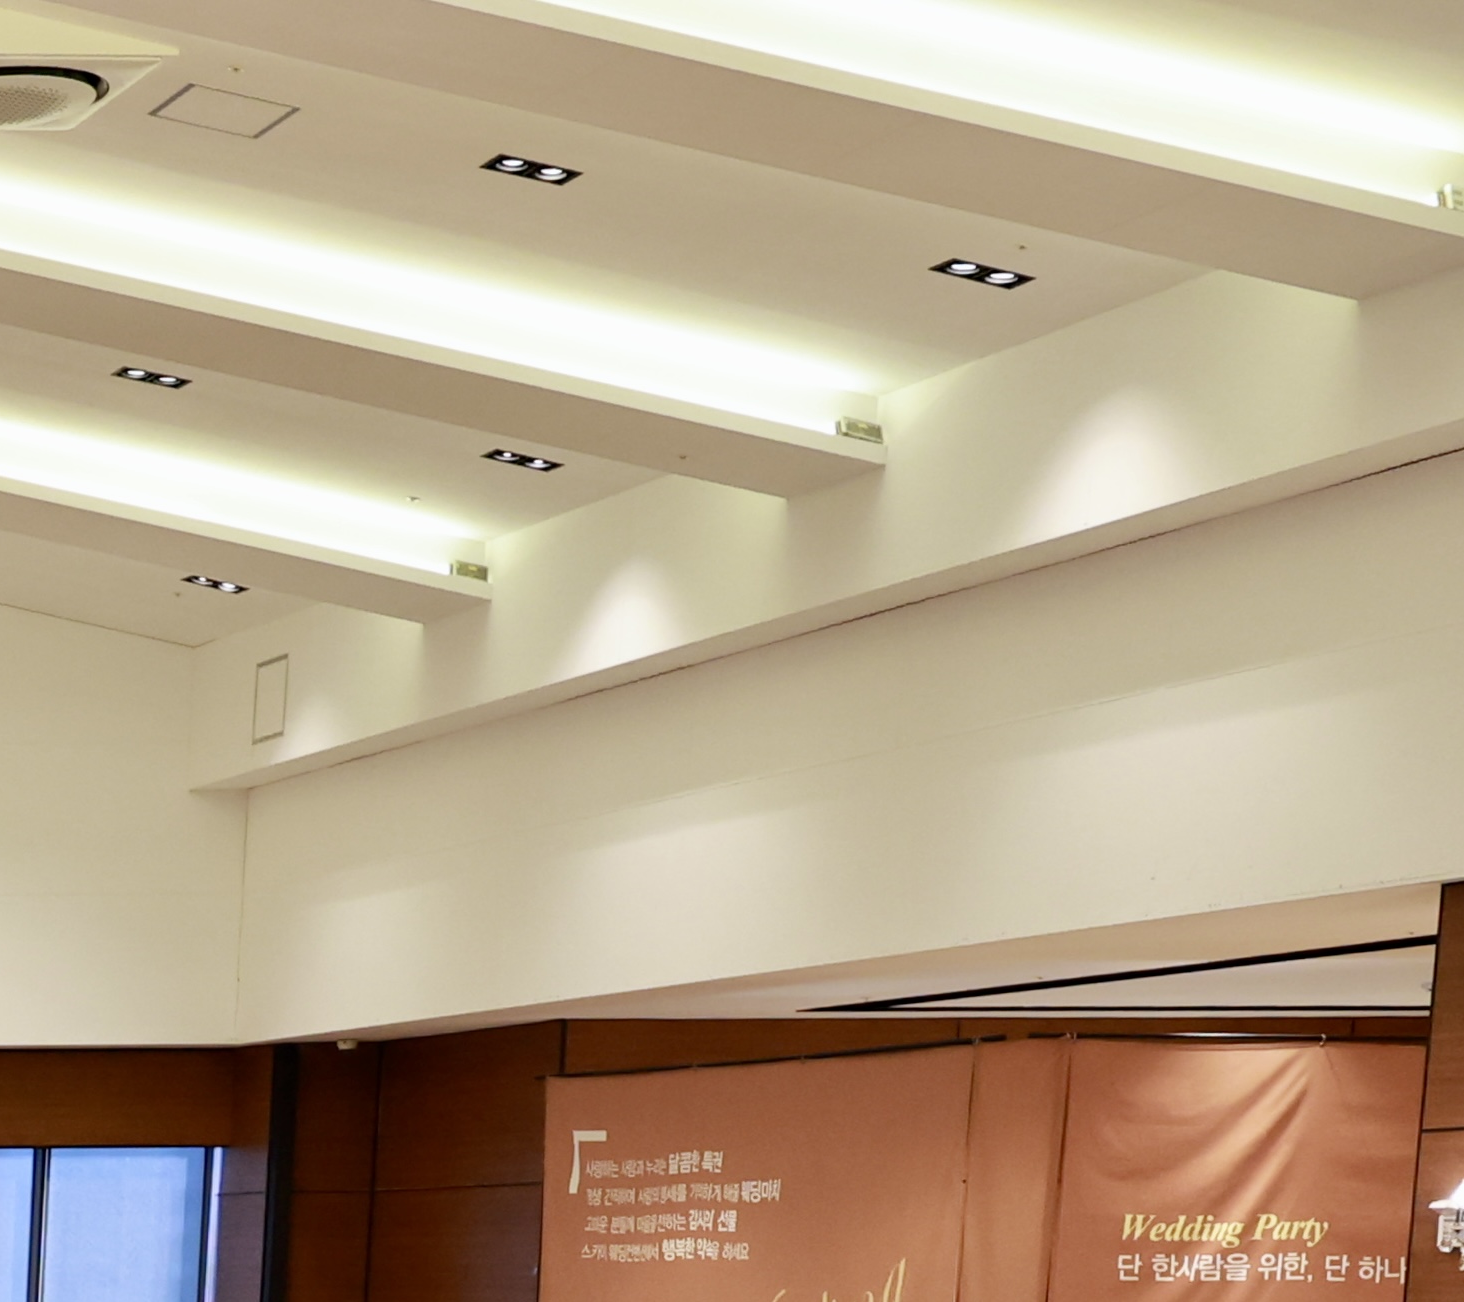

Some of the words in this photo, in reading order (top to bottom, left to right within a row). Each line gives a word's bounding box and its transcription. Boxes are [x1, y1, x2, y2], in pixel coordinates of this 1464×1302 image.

[668, 1149, 701, 1174] 달콤한
[702, 1150, 724, 1173] 특권
[1122, 1212, 1246, 1249] Wedding
[1250, 1212, 1330, 1248] Party
[1117, 1253, 1143, 1283] 단
[1151, 1252, 1251, 1283] 한사람을
[1257, 1252, 1313, 1284] 위한,
[1324, 1253, 1350, 1283] 단
